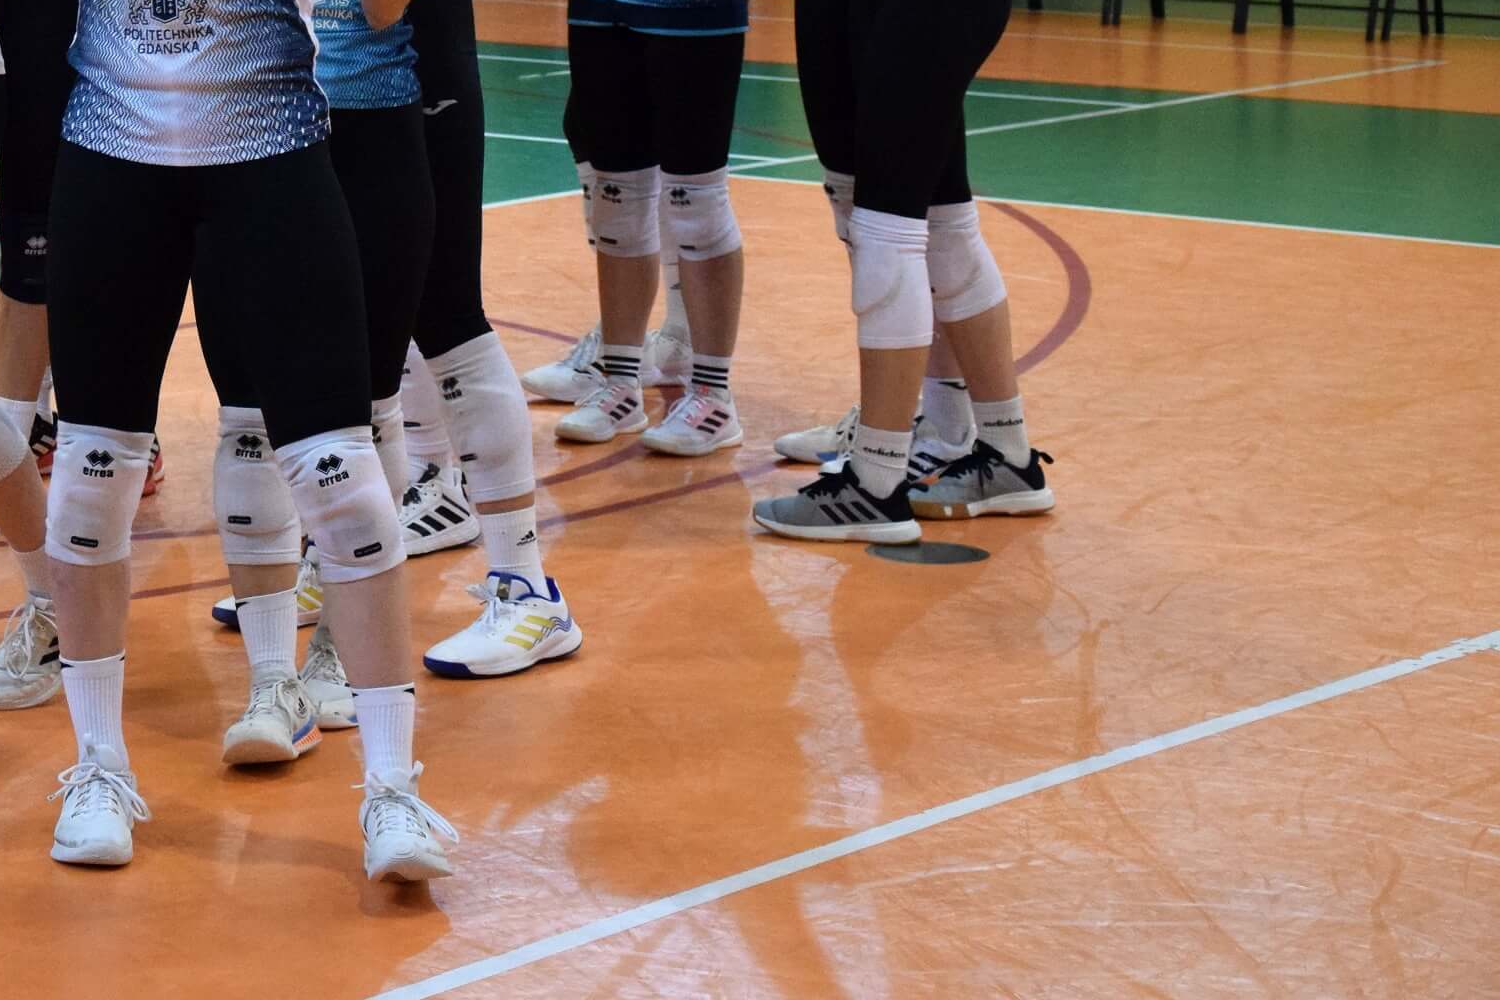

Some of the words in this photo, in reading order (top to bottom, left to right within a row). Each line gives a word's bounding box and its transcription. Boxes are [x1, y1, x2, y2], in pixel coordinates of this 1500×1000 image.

[124, 25, 214, 41] POLITECHNIKA
[137, 40, 200, 55] GDAŃSKA
[235, 448, 262, 459] errea
[83, 466, 114, 478] errea
[318, 470, 349, 488] errea
